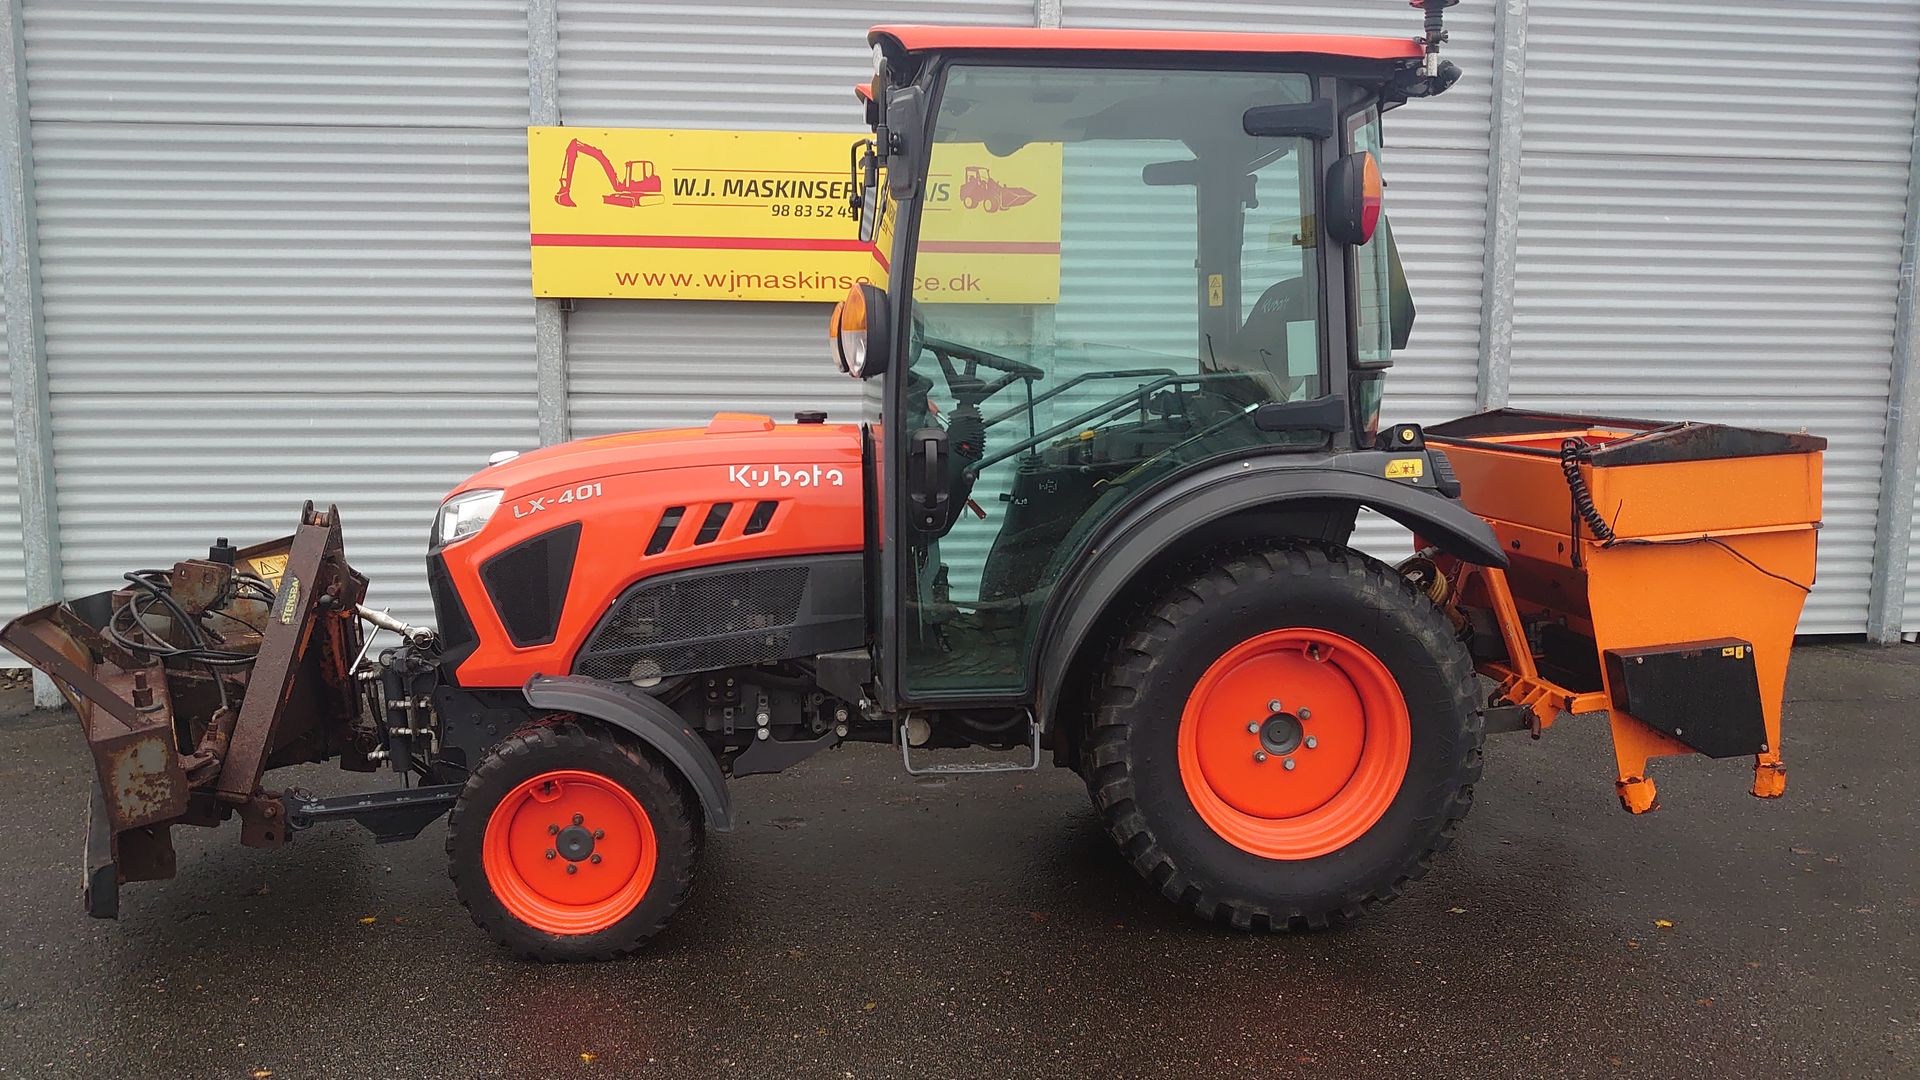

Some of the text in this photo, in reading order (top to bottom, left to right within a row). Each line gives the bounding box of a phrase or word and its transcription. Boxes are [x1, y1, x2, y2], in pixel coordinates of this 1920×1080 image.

[673, 178, 951, 203] W.J. MASKINSER /S
[771, 204, 854, 219] 98 83 52 49
[729, 464, 844, 488] Kubota
[512, 482, 603, 519] LX-401
